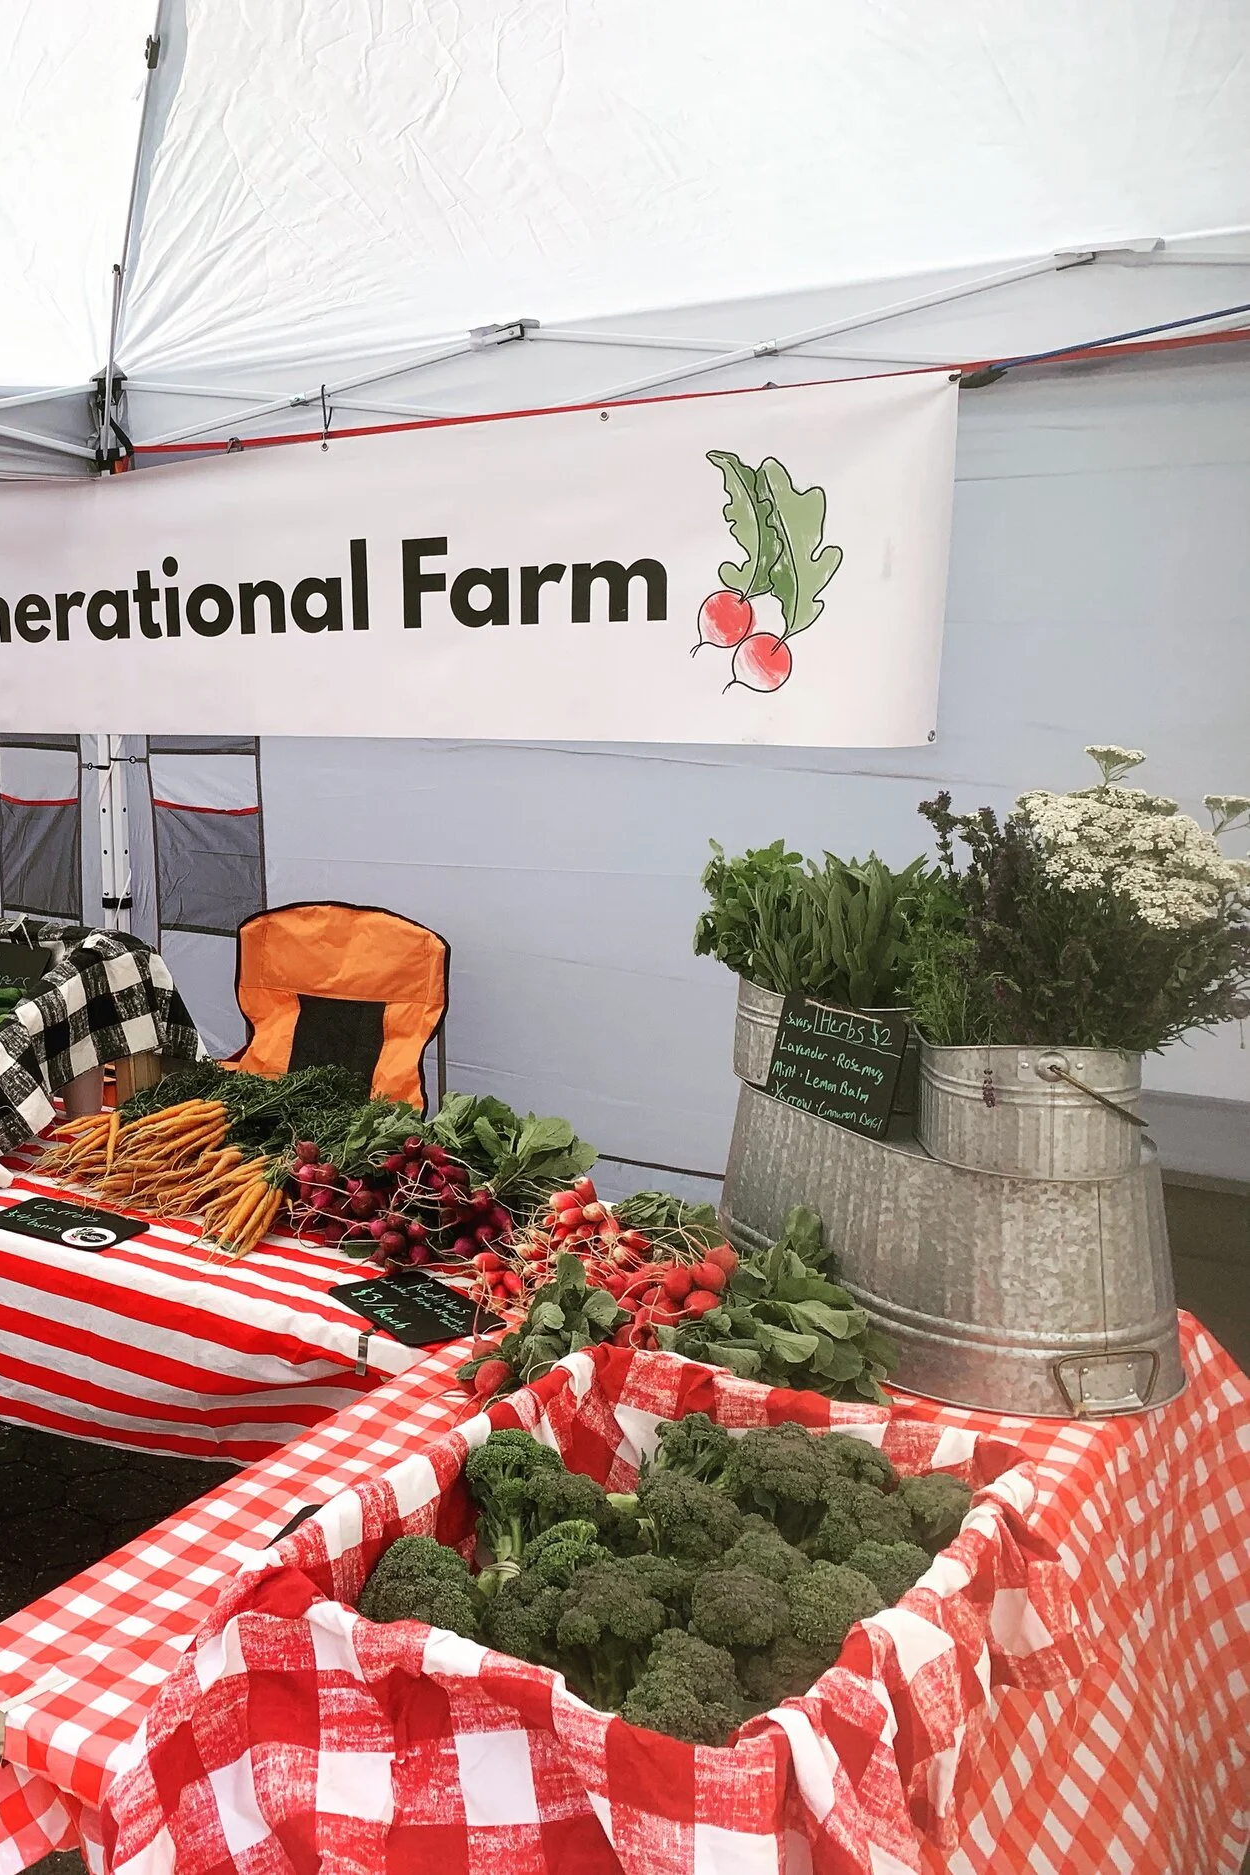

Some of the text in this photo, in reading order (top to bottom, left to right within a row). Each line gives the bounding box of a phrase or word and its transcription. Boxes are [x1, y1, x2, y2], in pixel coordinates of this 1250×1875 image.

[402, 536, 668, 629] Farm
[785, 1011, 812, 1033] Savory
[820, 1008, 893, 1046] Herbs $2
[779, 1031, 884, 1085] Lavender Rosemary
[772, 1061, 869, 1104] Mint Lemon Balm
[773, 1080, 812, 1110] Yarrow
[859, 1112, 883, 1132] Basil
[33, 1204, 102, 1222] Carrots
[407, 1283, 471, 1314] Radishes
